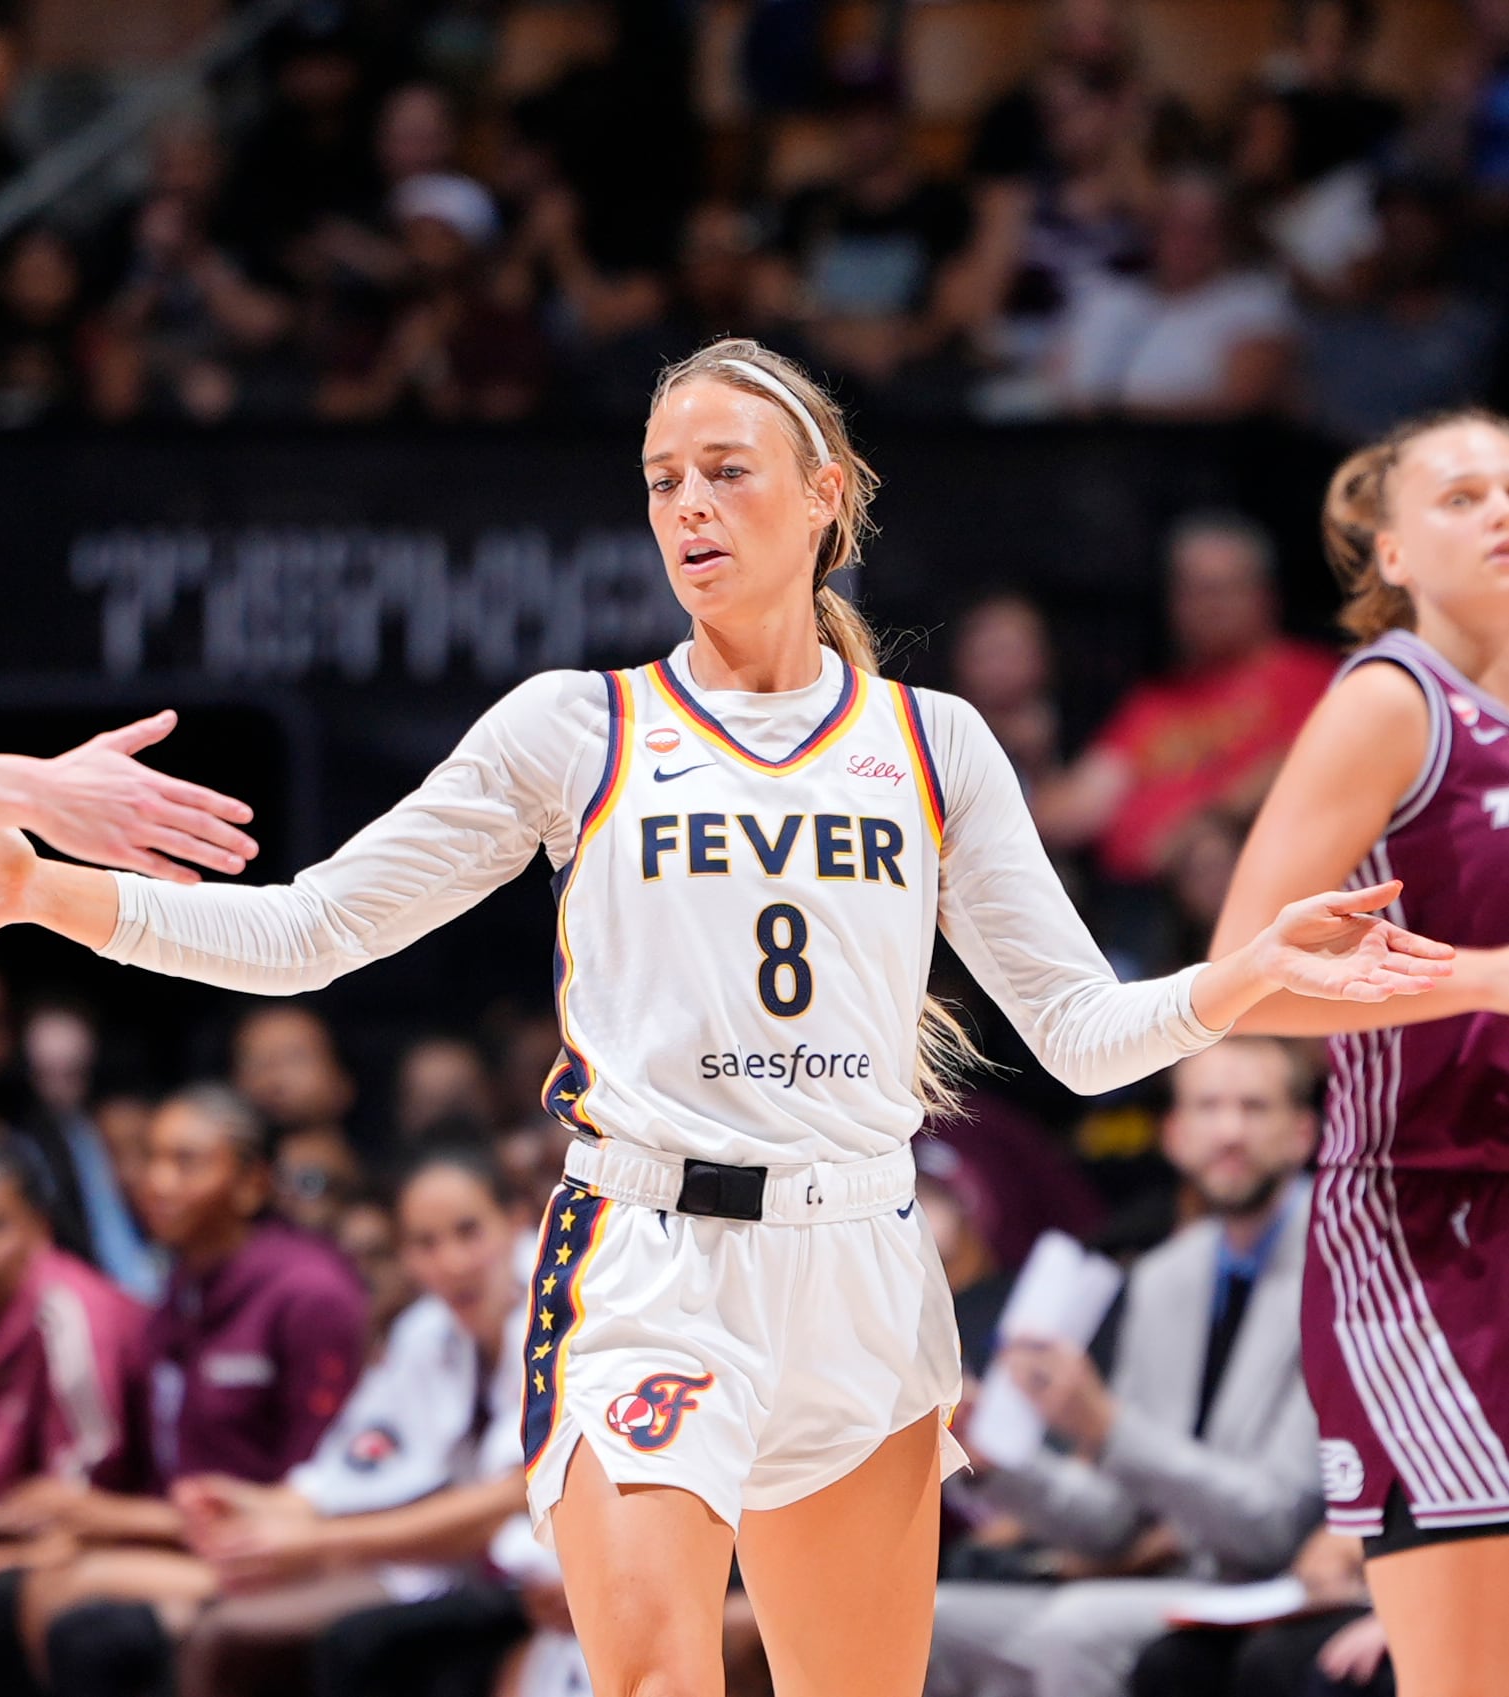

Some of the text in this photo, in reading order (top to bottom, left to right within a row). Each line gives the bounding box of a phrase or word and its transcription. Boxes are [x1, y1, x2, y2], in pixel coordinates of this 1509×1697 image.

[846, 754, 907, 787] Lilly
[639, 812, 909, 891] FEVER
[753, 900, 815, 1021] 8
[700, 1044, 871, 1088] salesforce
